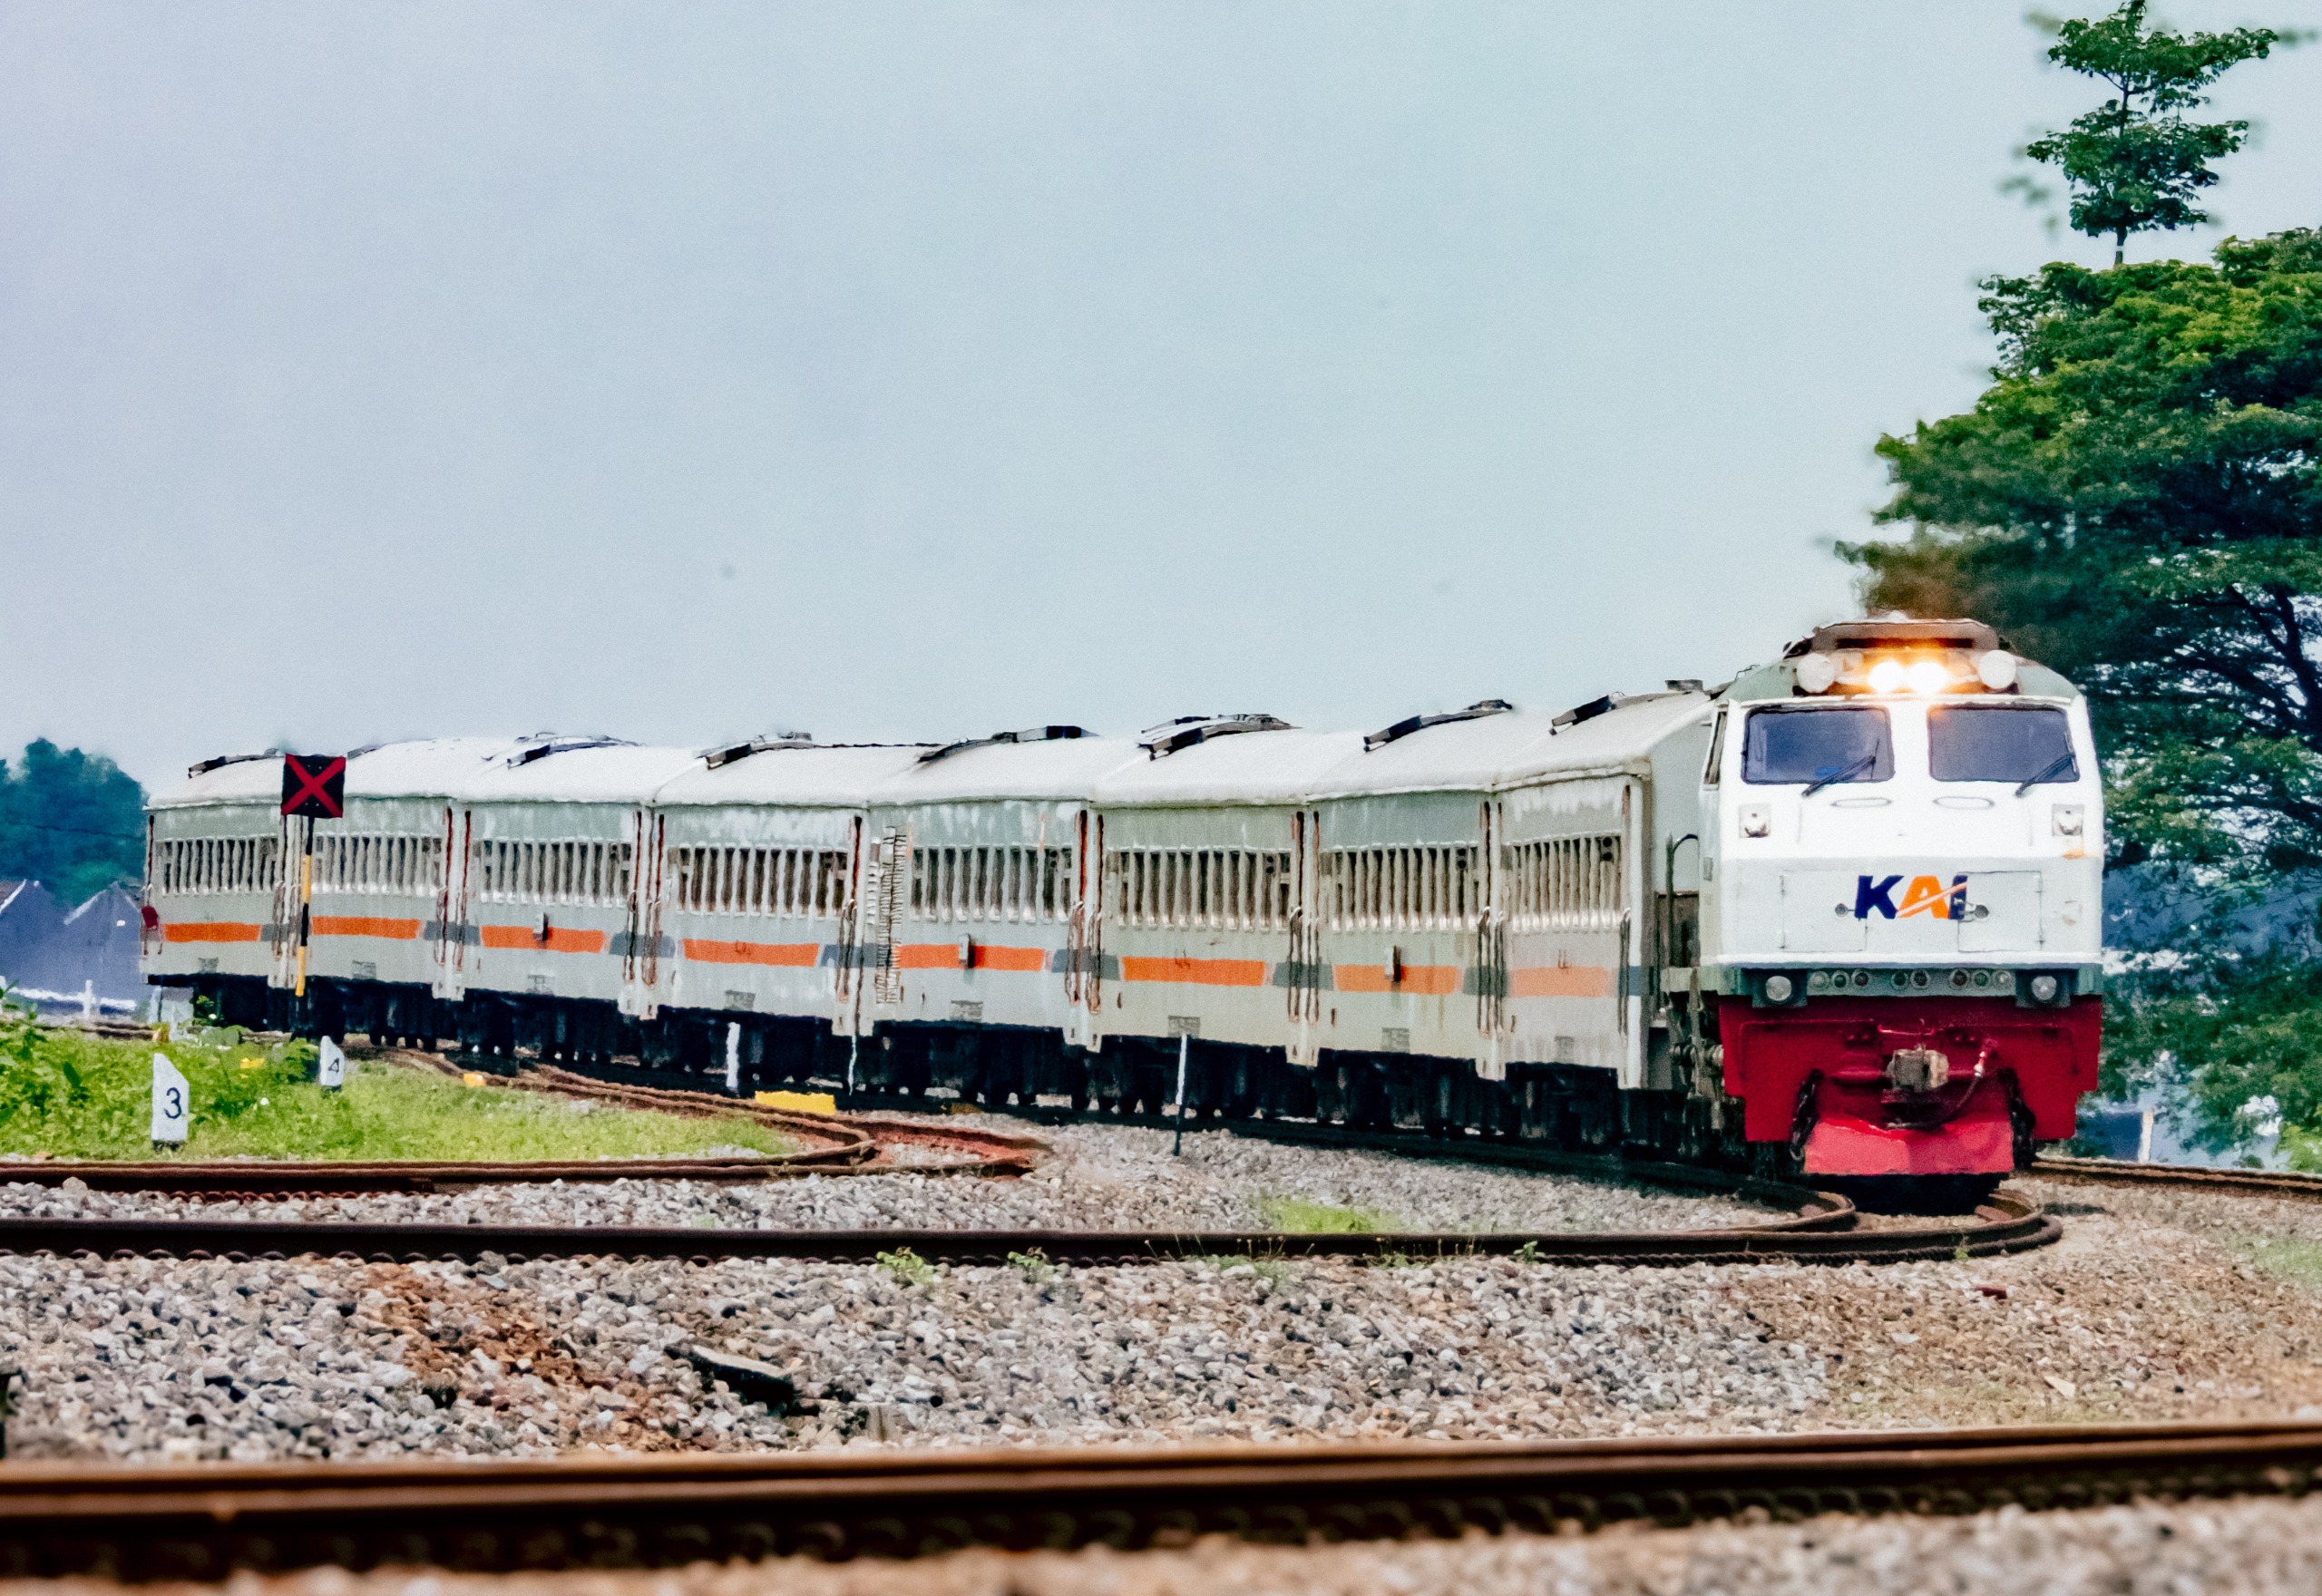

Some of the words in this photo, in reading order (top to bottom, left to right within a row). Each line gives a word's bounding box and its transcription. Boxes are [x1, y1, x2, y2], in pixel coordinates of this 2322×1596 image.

[1855, 875, 1967, 920] KAI
[328, 1058, 340, 1073] 4
[164, 1087, 182, 1119] 3
